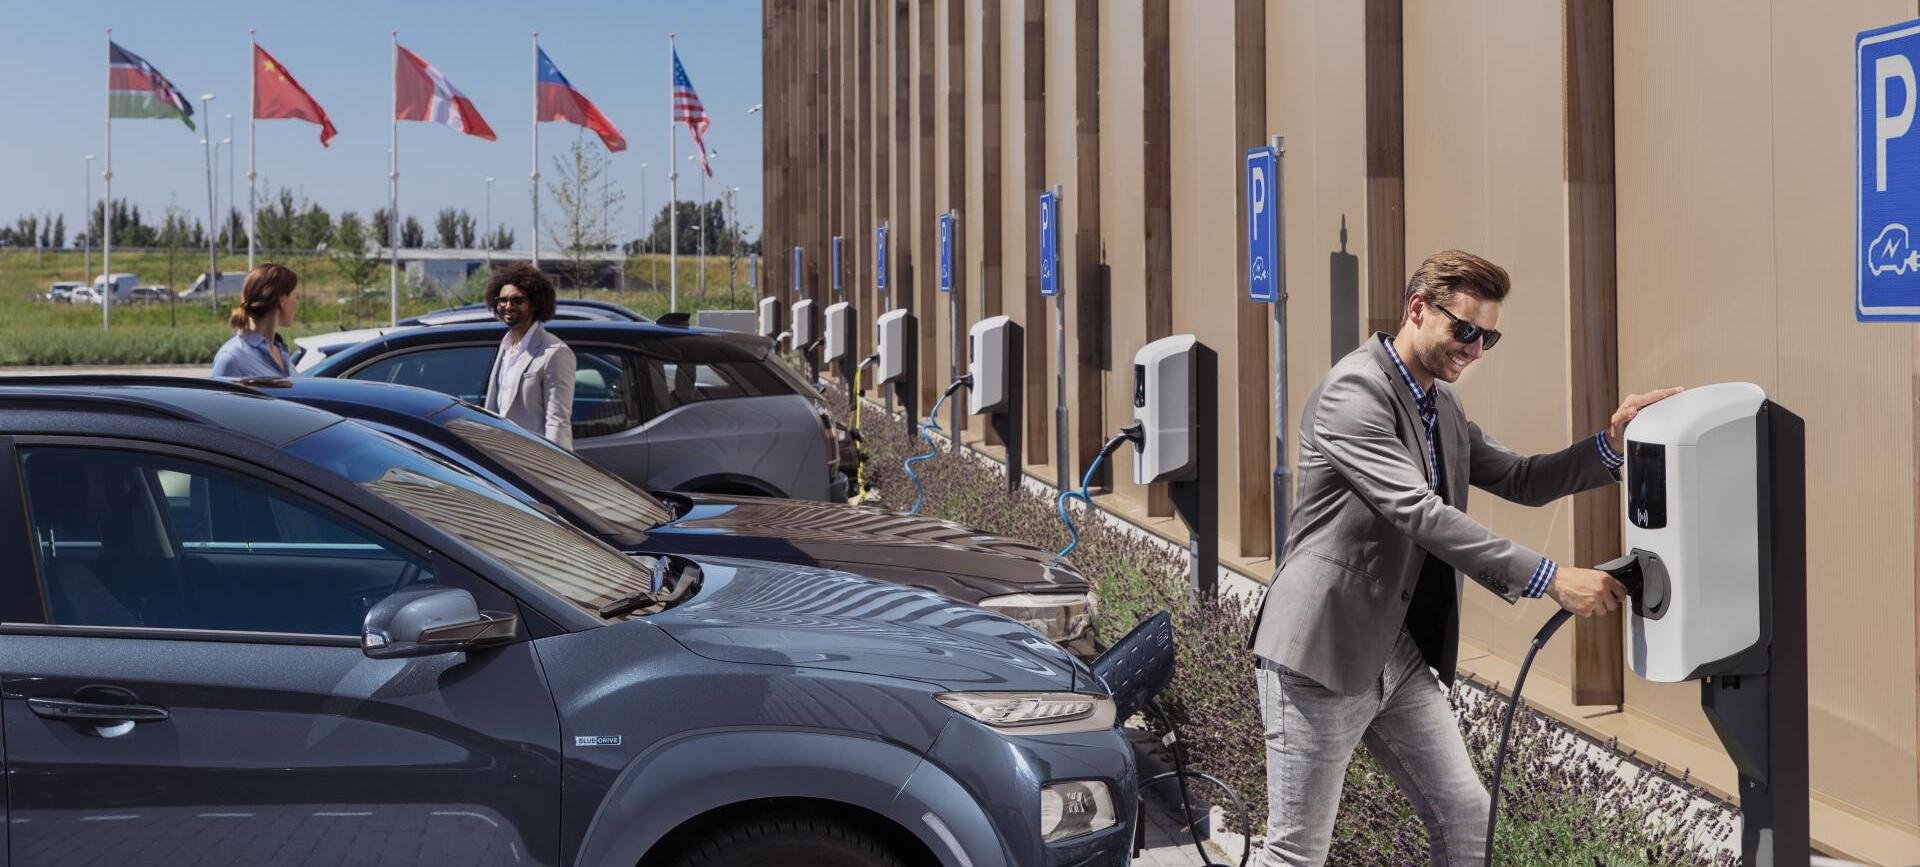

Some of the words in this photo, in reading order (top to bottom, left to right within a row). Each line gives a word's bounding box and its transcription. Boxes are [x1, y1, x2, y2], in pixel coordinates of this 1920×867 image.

[1875, 54, 1917, 192] P
[1042, 202, 1049, 249] P
[1252, 166, 1265, 241] P
